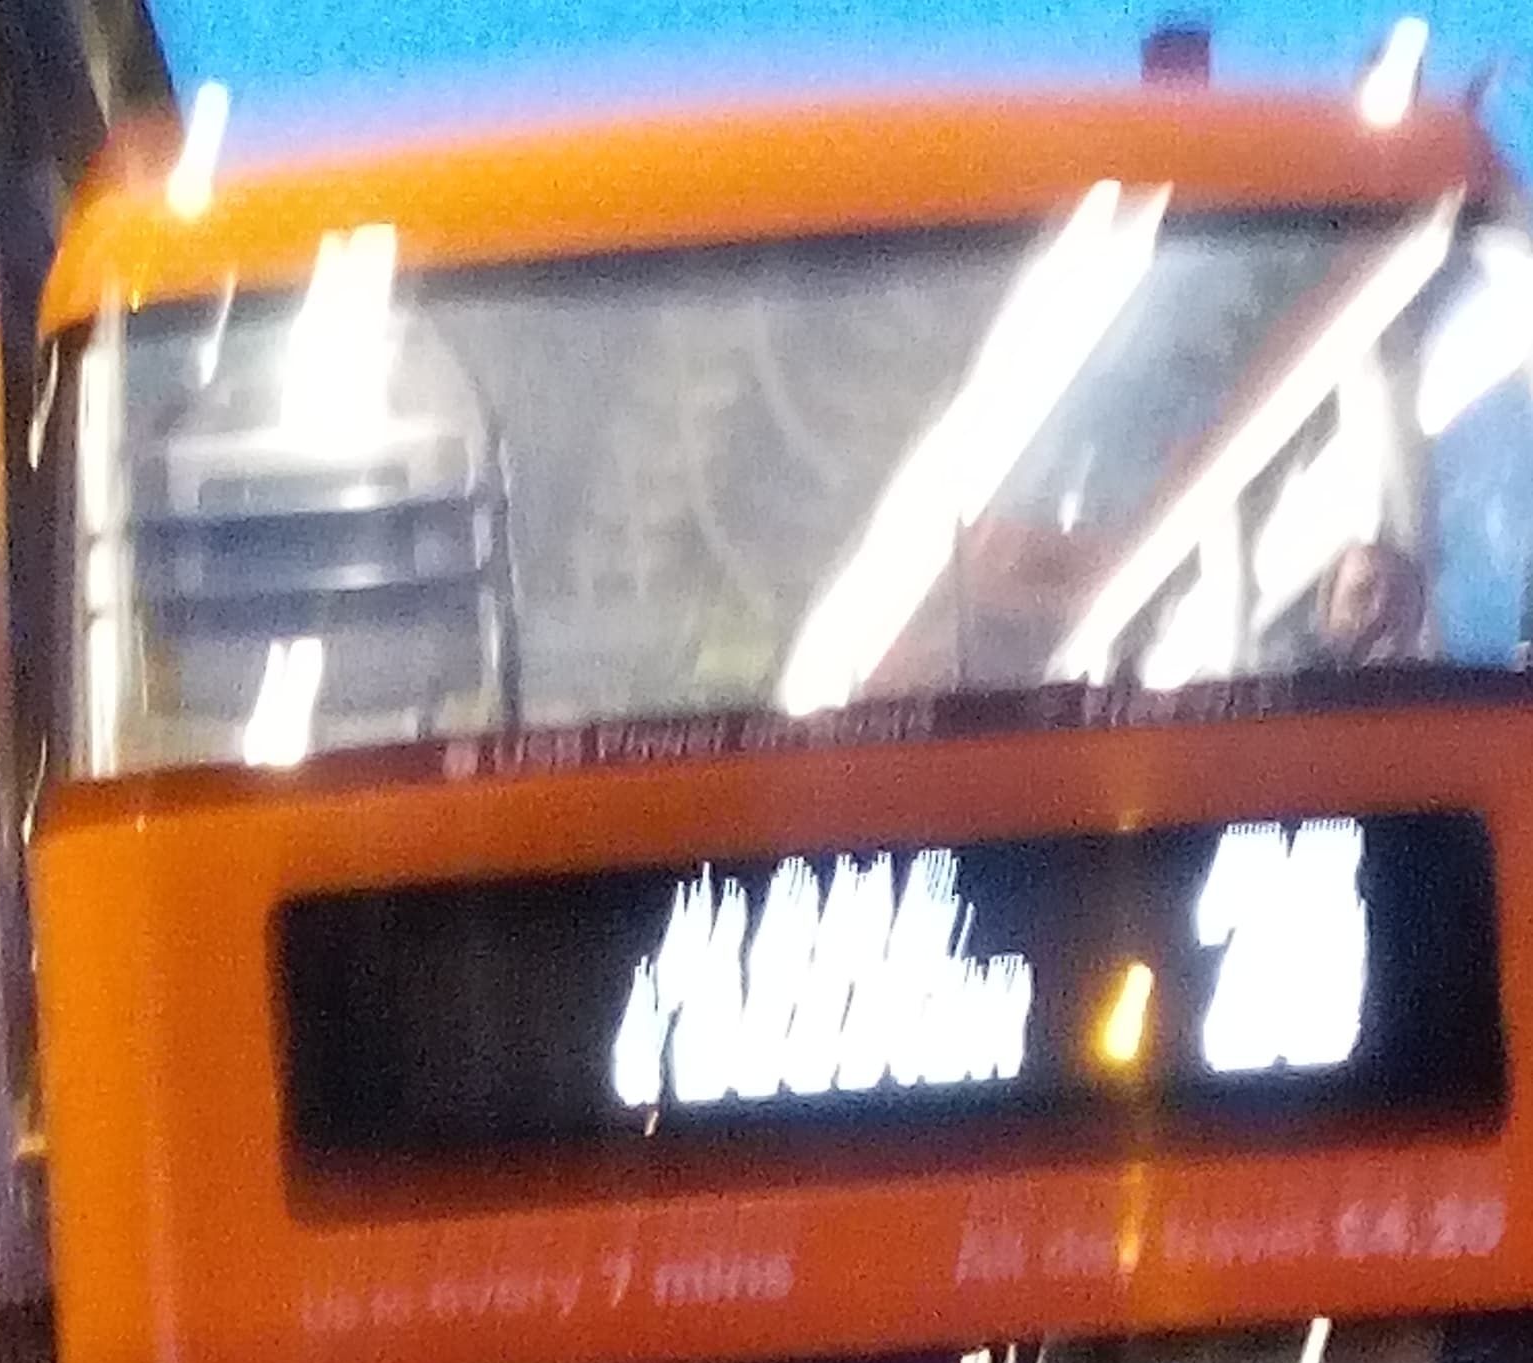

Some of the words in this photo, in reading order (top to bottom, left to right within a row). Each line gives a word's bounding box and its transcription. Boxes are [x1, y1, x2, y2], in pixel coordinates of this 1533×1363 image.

[428, 1268, 583, 1317] every
[600, 1247, 637, 1308] 7
[653, 1250, 796, 1308] mins
